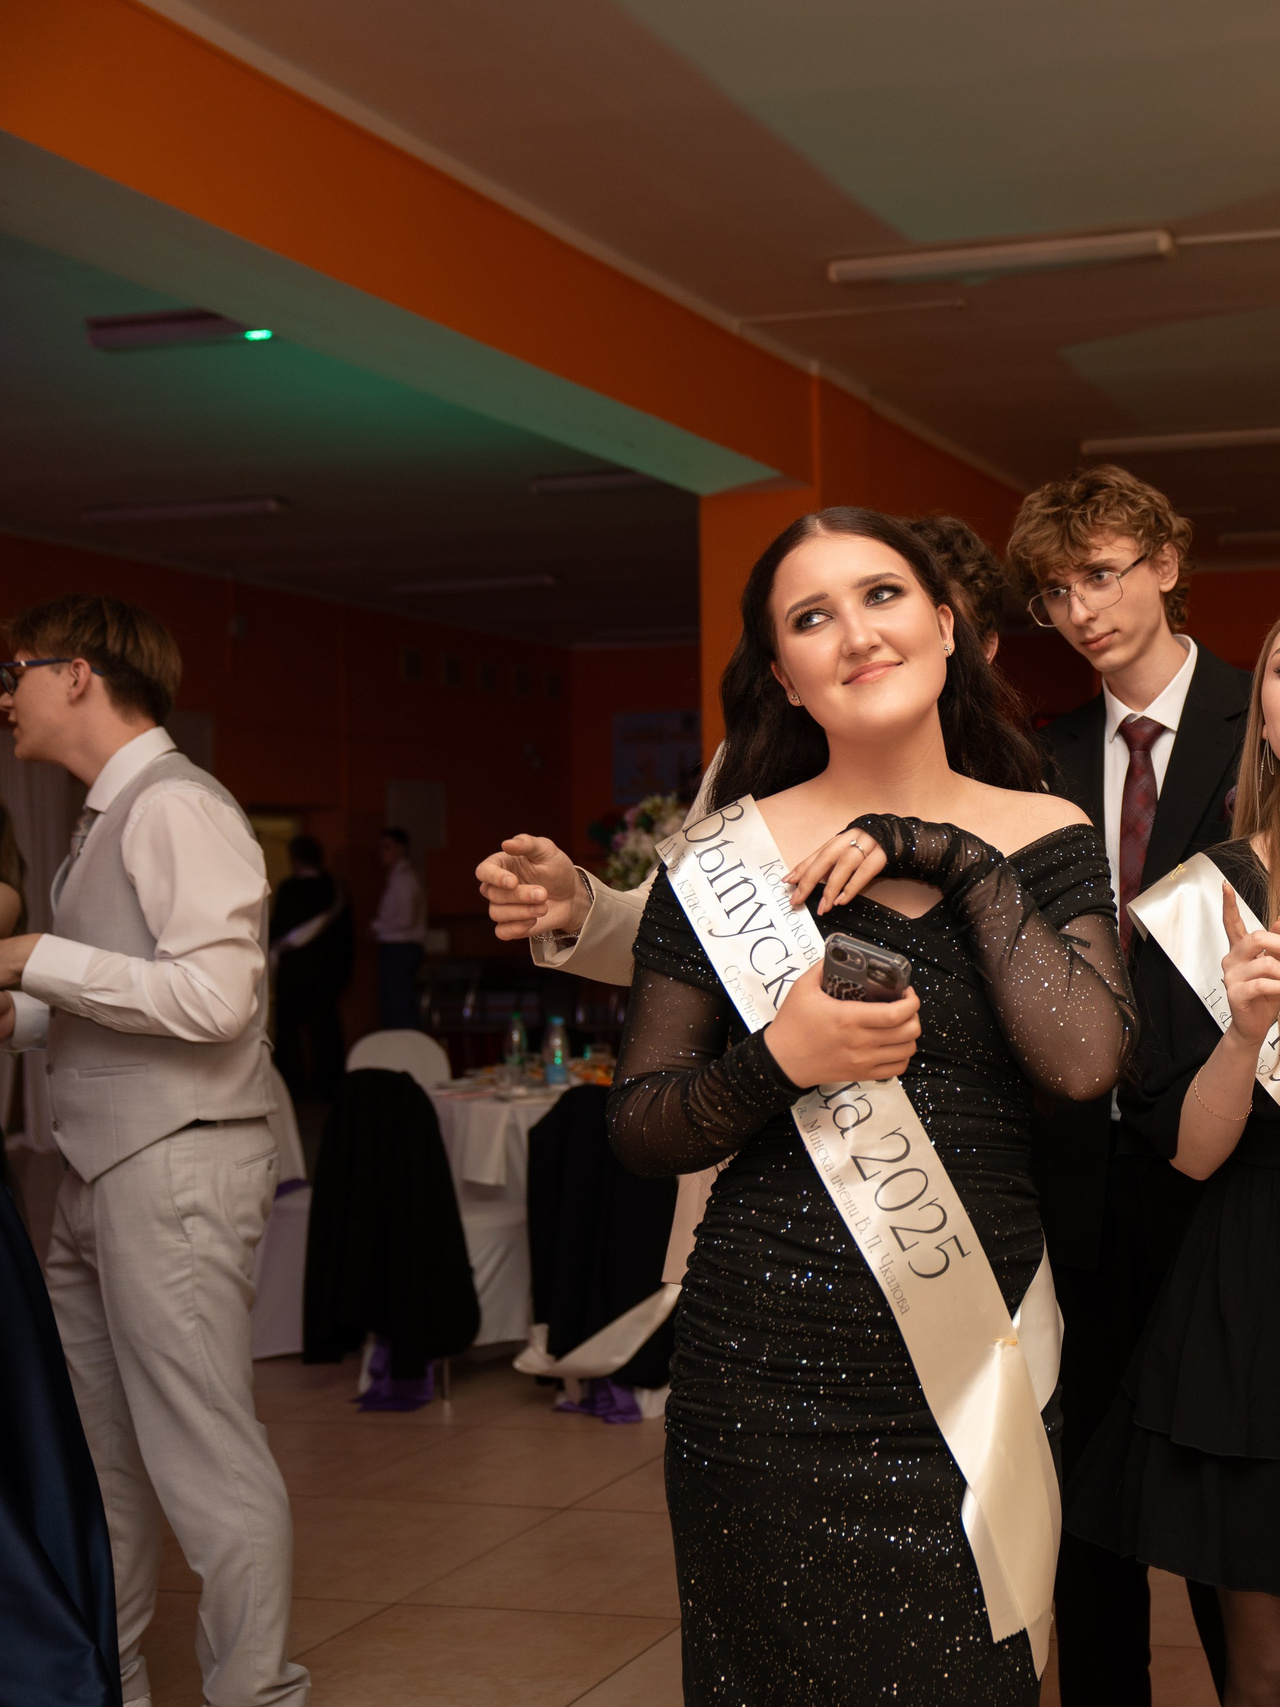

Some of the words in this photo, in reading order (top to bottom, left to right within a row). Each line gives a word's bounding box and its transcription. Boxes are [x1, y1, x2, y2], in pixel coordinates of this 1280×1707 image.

[659, 838, 677, 858] 11
[677, 879, 712, 928] класс
[1203, 988, 1222, 1010] 11
[803, 1119, 835, 1173] Минска
[830, 1174, 860, 1217] имени
[854, 1216, 872, 1235] В.
[864, 1236, 881, 1254] П.
[876, 1252, 912, 1316] Чкалова
[850, 1126, 971, 1279] 2025
